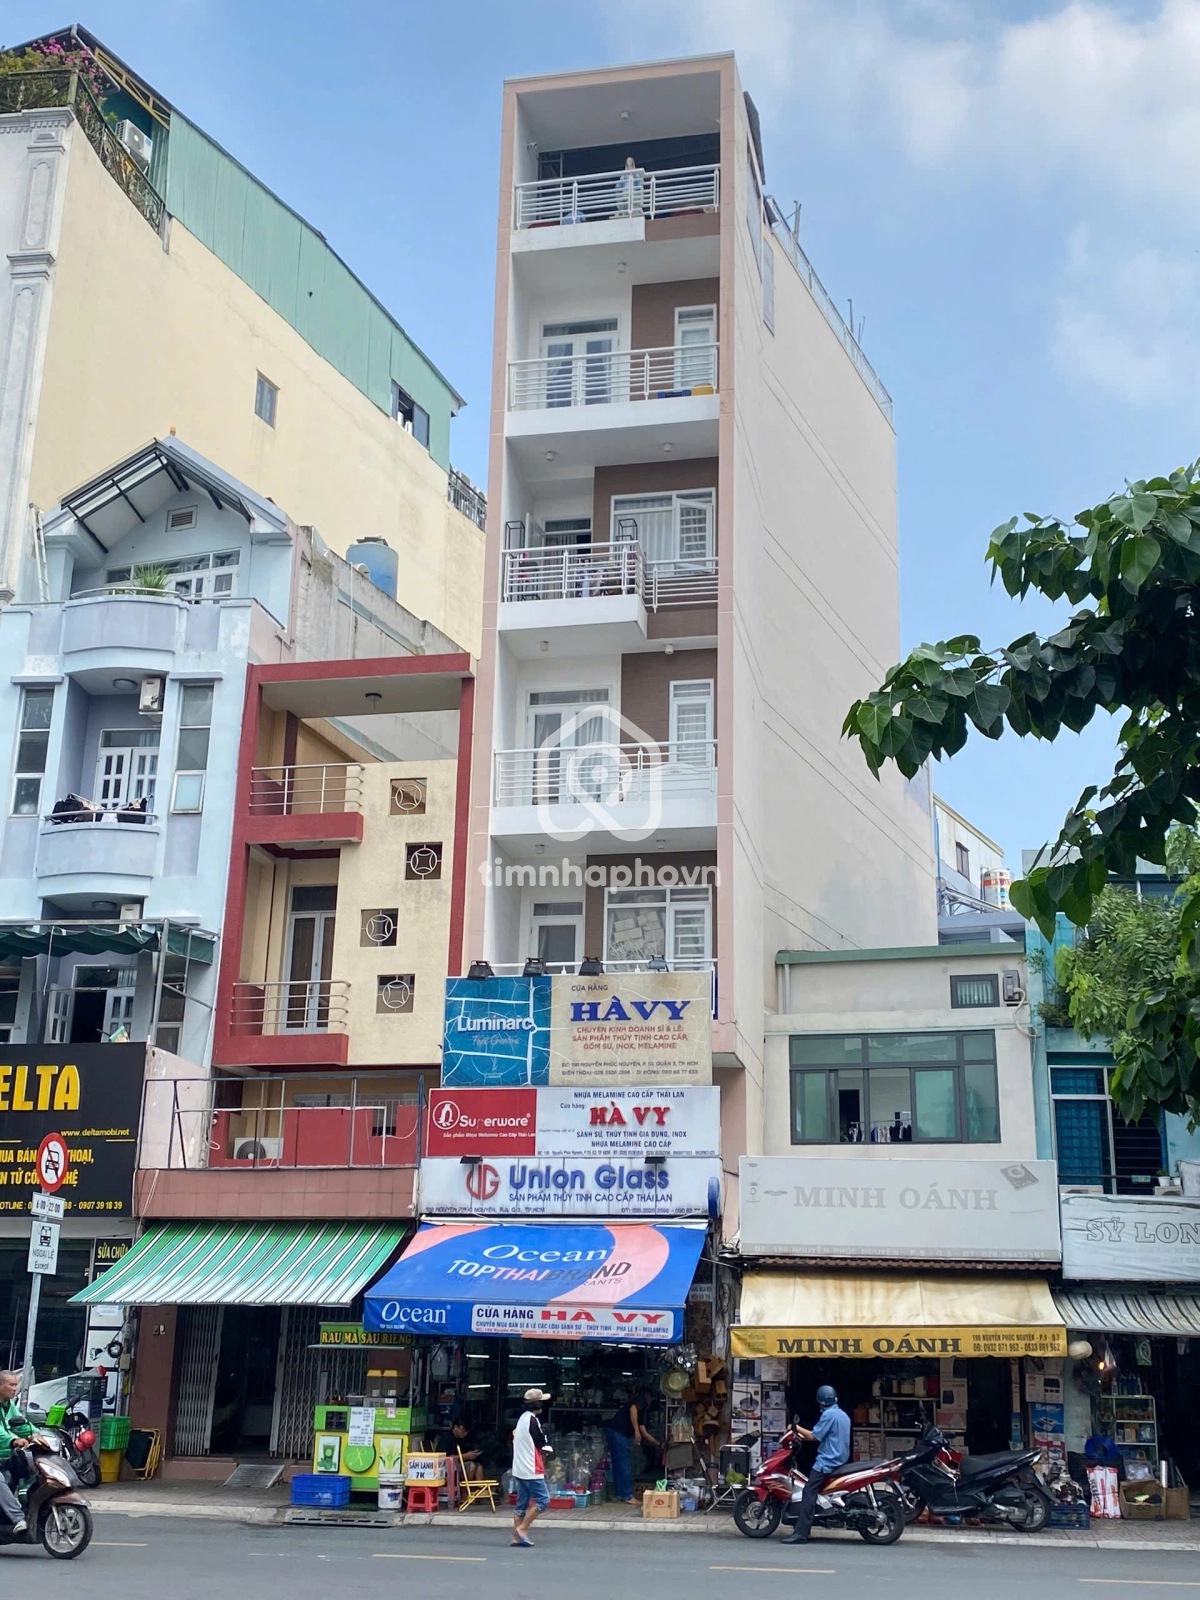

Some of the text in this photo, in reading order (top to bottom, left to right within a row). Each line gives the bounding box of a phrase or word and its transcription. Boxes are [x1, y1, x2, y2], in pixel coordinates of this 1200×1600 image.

[457, 1015, 532, 1032] Luminarc
[572, 1033, 588, 1041] SẢN
[589, 1033, 611, 1041] PHẨM
[583, 1041, 601, 1050] GỐM
[616, 1043, 636, 1051] INOX,
[638, 1042, 677, 1050] MELAMINE
[627, 1091, 640, 1099] CAO
[641, 1089, 654, 1098] CẤP
[656, 1090, 671, 1098] THÁI
[589, 1101, 671, 1126] HÀ VY
[460, 1115, 529, 1129] Suerware
[61, 1128, 130, 1137] www.deltamobi.net
[606, 1130, 622, 1138] THỦY
[658, 1139, 672, 1148] CẤP
[17, 1147, 37, 1163] BÁN
[10, 1167, 24, 1185] TỬ
[509, 1165, 585, 1190] Union
[595, 1165, 669, 1190] Glass
[509, 1190, 673, 1202] SẢN PHẨM THỦY TINH CAO CẤP THÁI LAN
[793, 1182, 999, 1210] MINH OÁNH
[79, 1201, 95, 1210] 0907
[96, 1201, 105, 1210] 39
[106, 1201, 113, 1210] 18
[114, 1201, 123, 1210] 39
[1085, 1216, 1200, 1244] SỸ LON
[97, 1242, 110, 1258] SỬA
[483, 1244, 607, 1263] Ocean
[34, 1261, 49, 1271] Except
[381, 1301, 446, 1323] Ocean
[476, 1306, 665, 1324] CỬA HÀNG HÀ VY
[508, 1321, 518, 1329] BÁN
[537, 1321, 548, 1329] CÁC
[321, 1332, 341, 1343] RAU
[344, 1329, 358, 1343] MÁ
[776, 1338, 863, 1353] MINH
[872, 1333, 962, 1354] OÁNH
[984, 1343, 997, 1352] 0932
